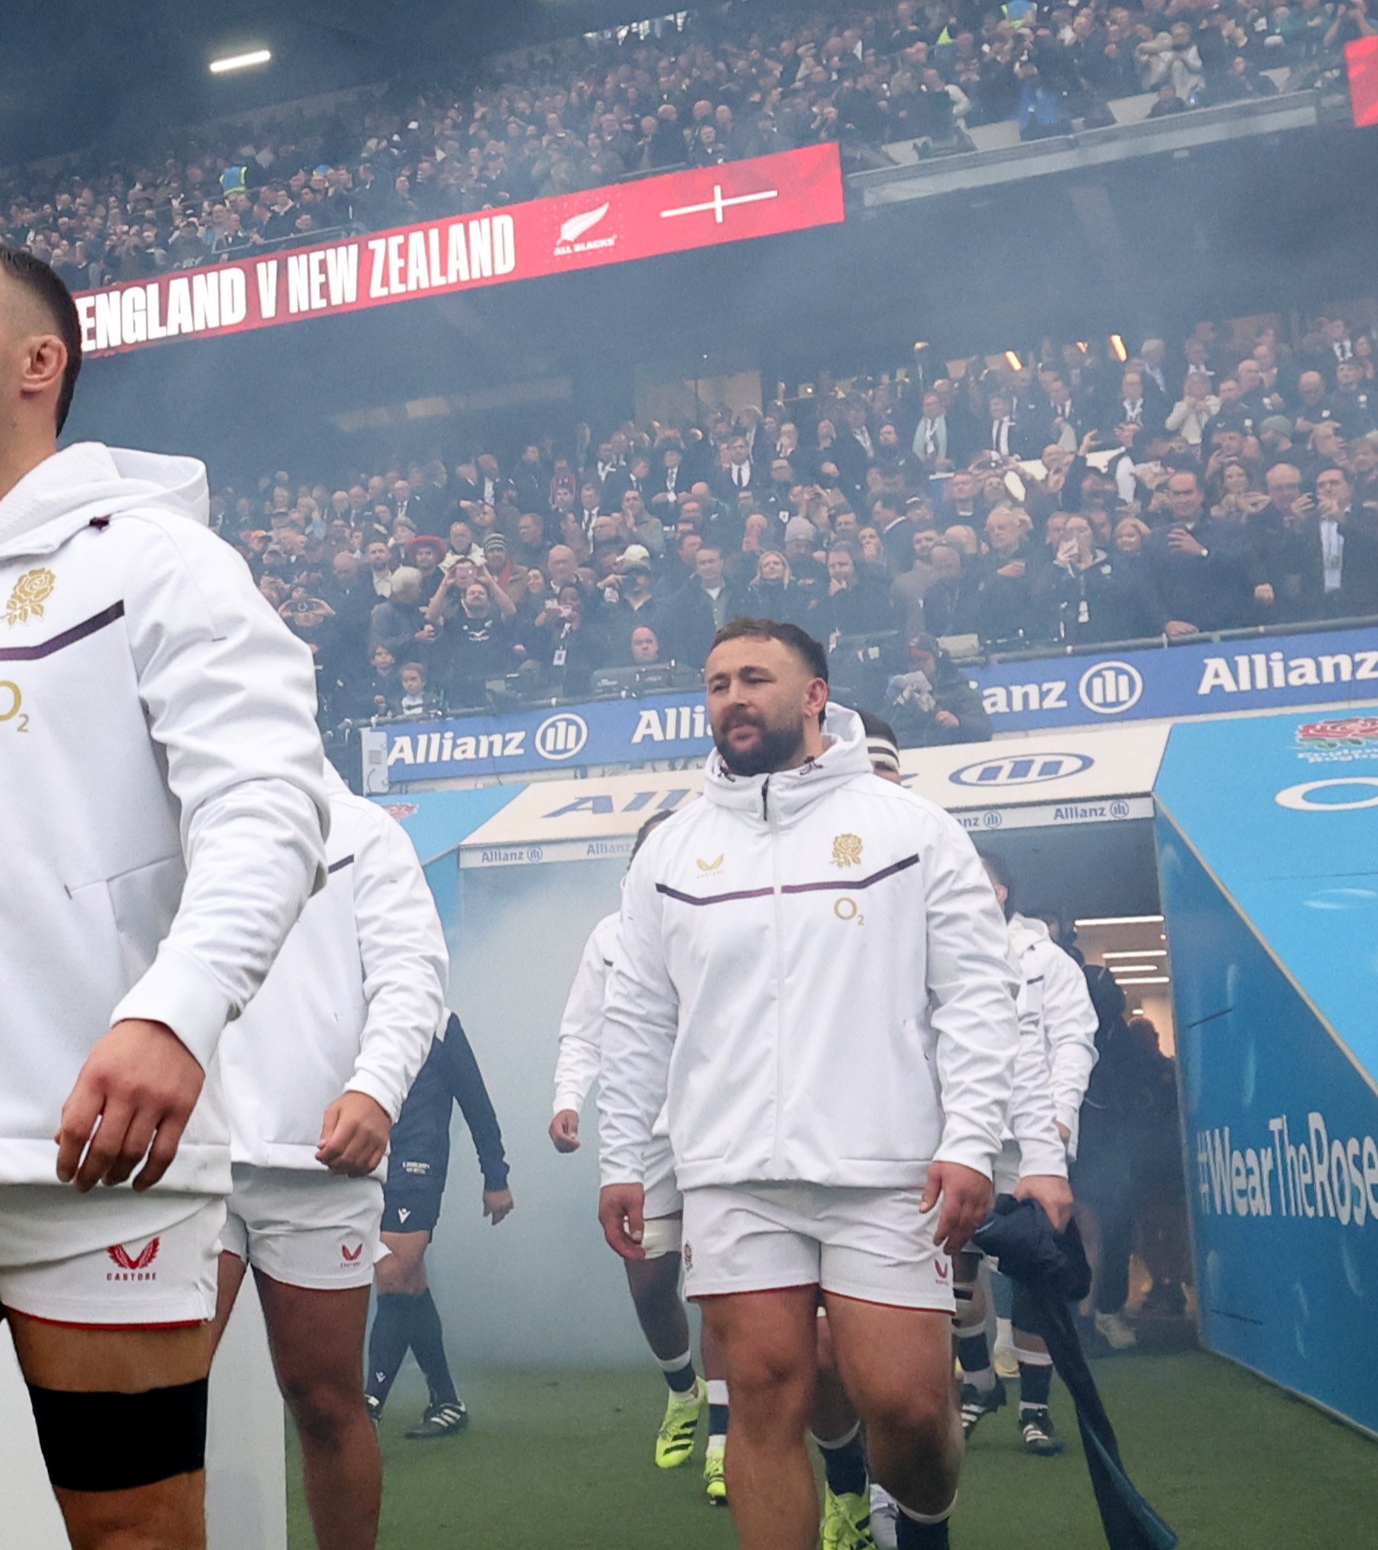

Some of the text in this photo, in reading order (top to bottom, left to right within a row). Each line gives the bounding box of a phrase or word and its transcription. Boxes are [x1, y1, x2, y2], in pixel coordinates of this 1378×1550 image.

[552, 238, 615, 256] ALL BLACKS
[79, 213, 516, 353] ENGLAND V NEW ZEALAND
[1197, 652, 1378, 696] Allianz
[969, 679, 1068, 716] anz
[386, 705, 710, 767] Allianz Alli
[1053, 806, 1107, 821] Allianz
[481, 848, 524, 864] Allianz
[1196, 1110, 1378, 1227] #WearTheRose
[106, 1272, 157, 1282] CASTORE
